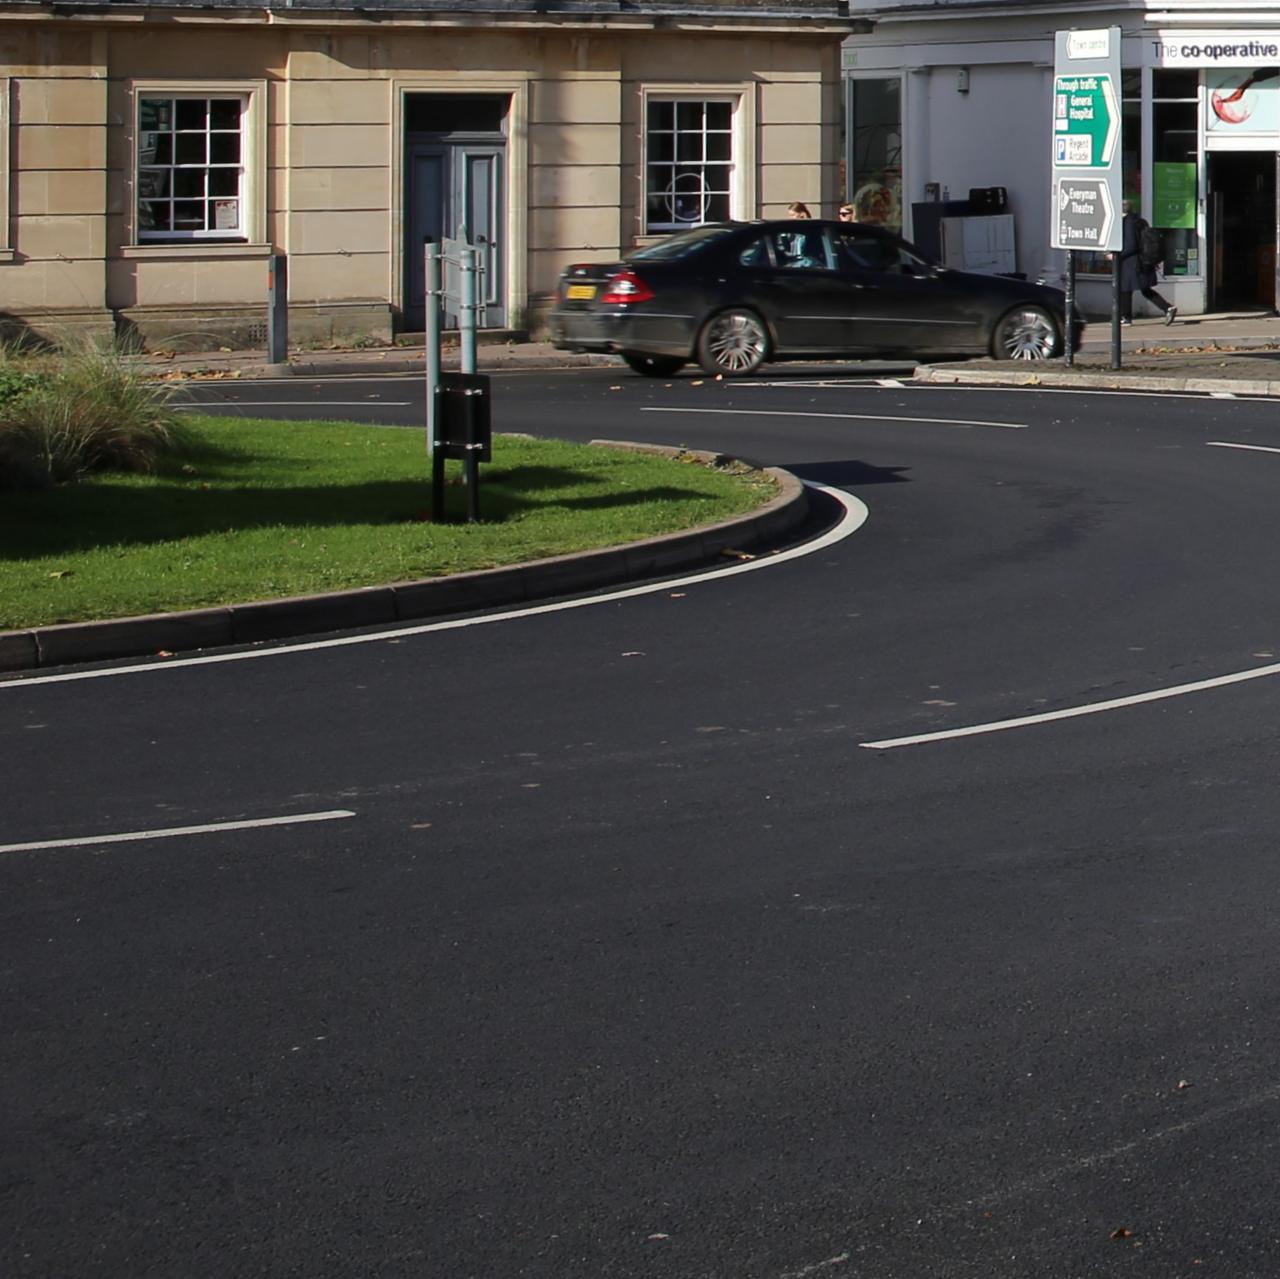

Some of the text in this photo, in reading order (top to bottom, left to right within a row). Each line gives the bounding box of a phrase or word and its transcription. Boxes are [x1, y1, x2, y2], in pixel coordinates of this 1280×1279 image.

[1152, 41, 1178, 58] The
[1181, 40, 1278, 60] co-operative
[1057, 77, 1098, 93] Through traffic
[1070, 94, 1093, 107] General
[1069, 107, 1094, 121] Hospital
[1069, 187, 1097, 202] Everyman
[1071, 201, 1094, 215] Theatre
[1067, 226, 1098, 240] Town Hall
